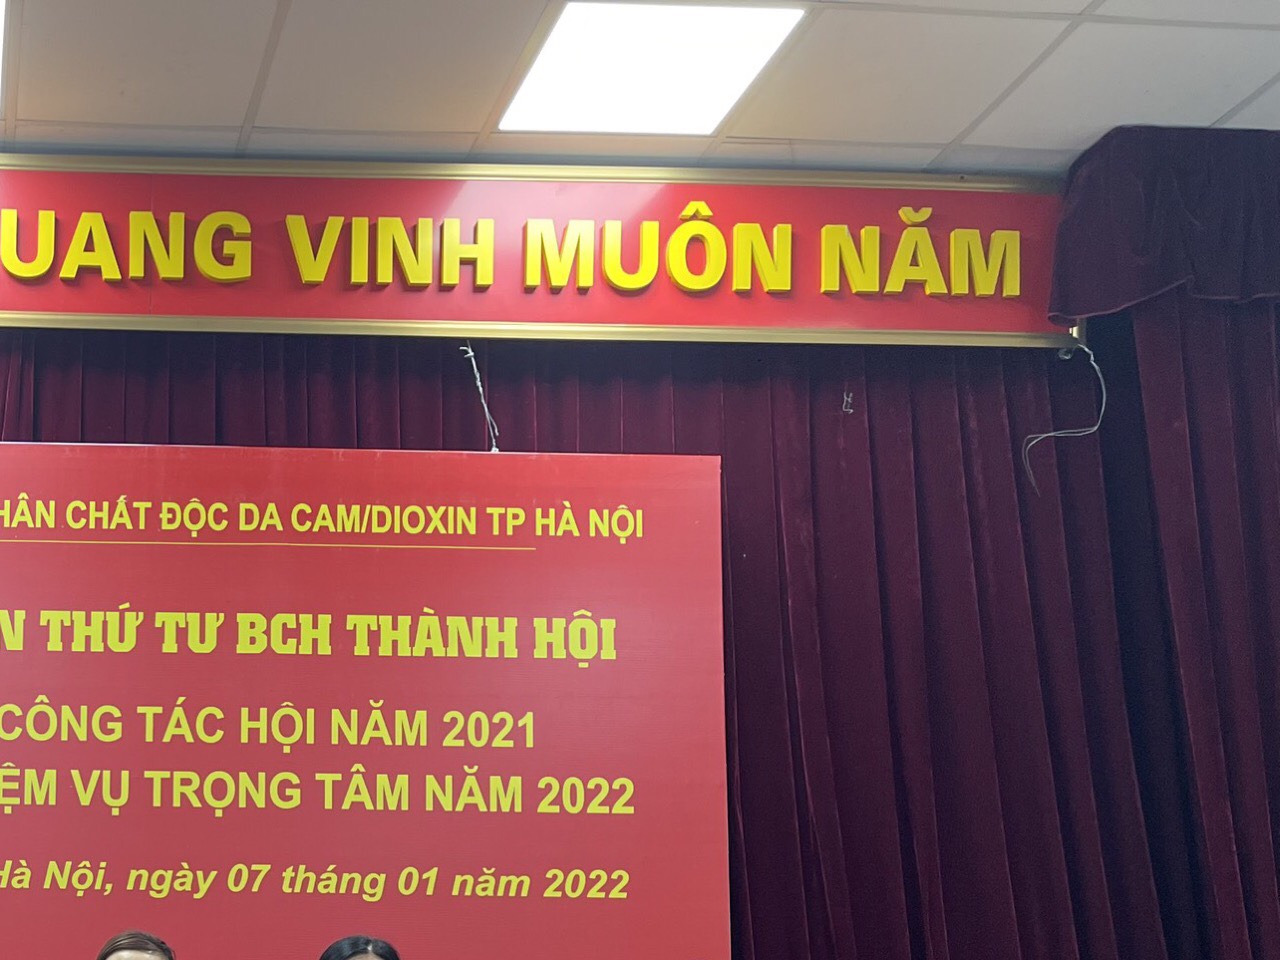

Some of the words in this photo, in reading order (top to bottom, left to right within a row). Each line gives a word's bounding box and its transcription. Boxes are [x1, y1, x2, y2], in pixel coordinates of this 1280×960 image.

[285, 214, 495, 287] VINH
[524, 200, 793, 293] MUÔN
[819, 206, 1022, 298] NĂM
[65, 494, 152, 530] CHẤT
[159, 497, 229, 538] ĐỘC
[239, 502, 284, 531] DA
[290, 503, 477, 536] CAM/DIOXIN
[485, 506, 527, 536] TP
[535, 500, 581, 537] HÀ
[589, 504, 643, 545] NỘI
[39, 602, 144, 653] THỨ
[154, 611, 225, 654] TƯ
[236, 612, 332, 656] BCH
[346, 607, 519, 659] THÀNH
[532, 608, 617, 669] HỘI
[136, 697, 225, 744] TÁC
[240, 701, 315, 754] HỘI
[331, 699, 428, 747] NĂM
[442, 710, 535, 748] 2021
[70, 769, 130, 816] VỤ
[143, 770, 301, 818] TRỌNG
[315, 763, 409, 811] TÂM
[425, 765, 522, 813] NĂM
[537, 776, 635, 815] 2022
[43, 860, 113, 897] Nội,
[126, 862, 218, 899] ngày
[227, 863, 271, 893] 07
[281, 864, 387, 902] tháng
[397, 866, 439, 896] 01
[451, 867, 531, 897] năm
[543, 868, 630, 899] 2022
